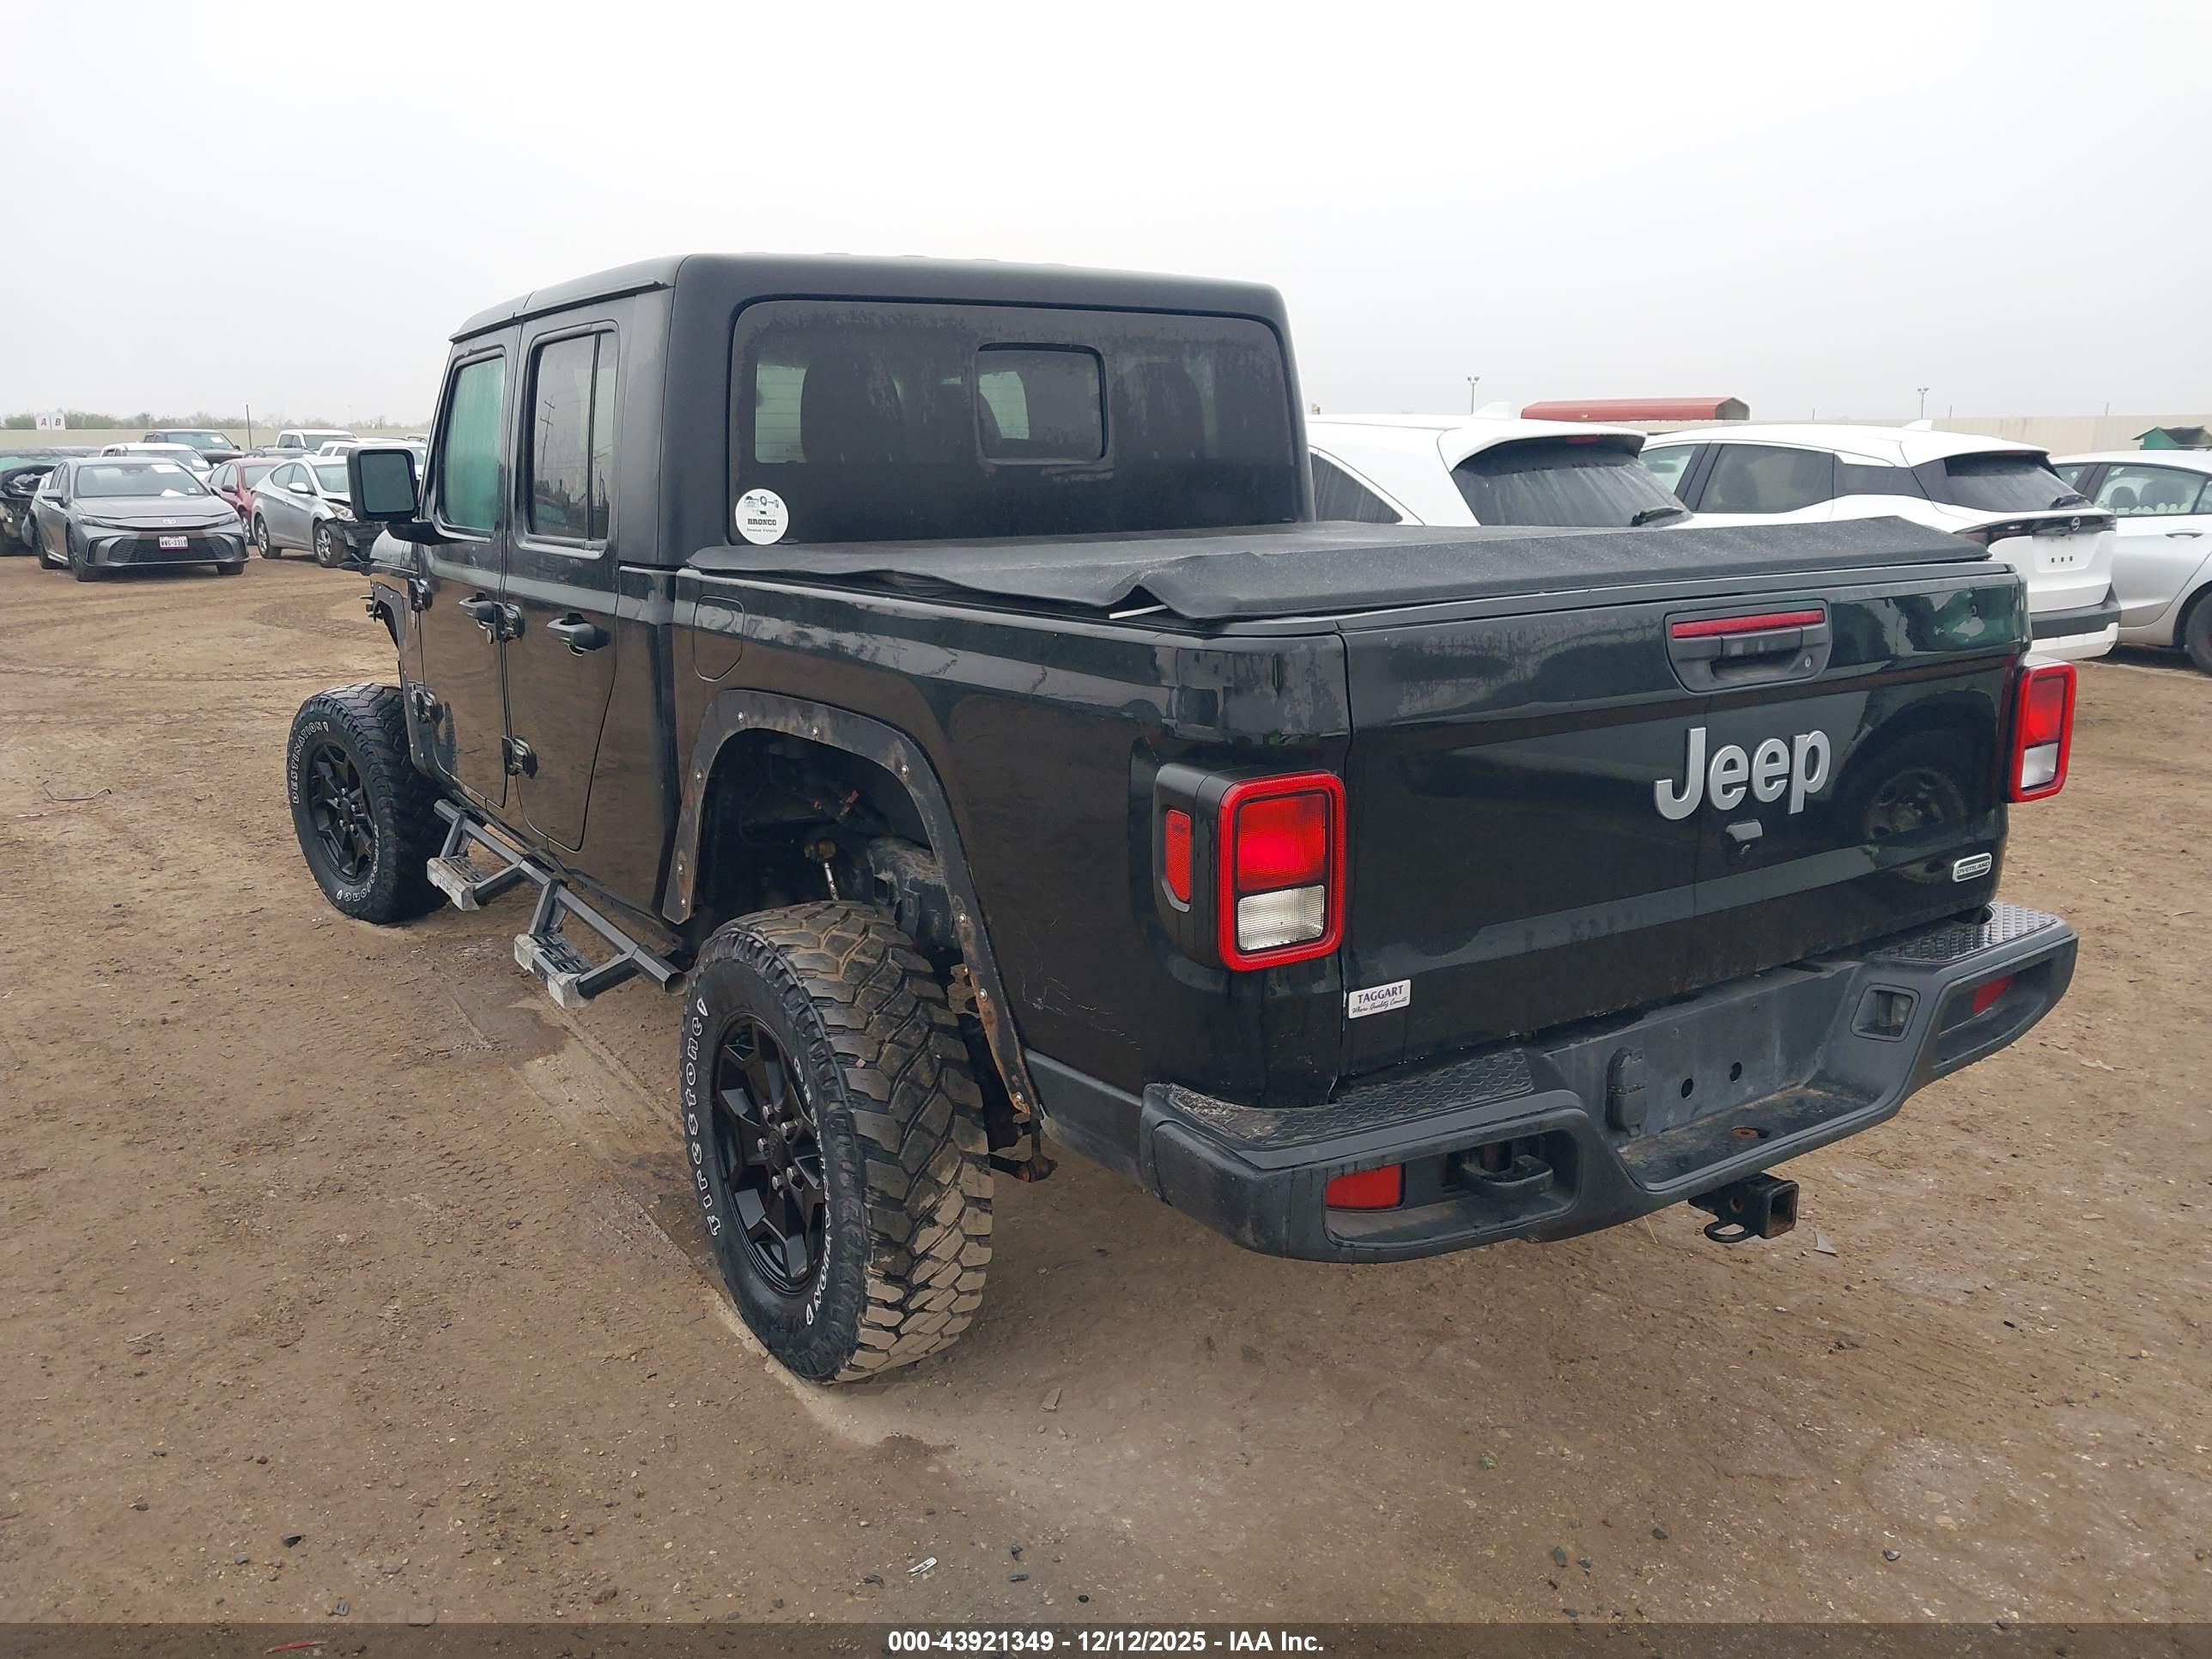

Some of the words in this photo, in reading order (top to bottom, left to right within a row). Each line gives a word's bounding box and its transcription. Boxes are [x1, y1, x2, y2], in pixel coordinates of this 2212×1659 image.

[40, 417, 47, 427] A
[55, 417, 62, 427] B
[1654, 726, 1831, 820] Jeep
[1358, 984, 1404, 1005] TAGGART
[1370, 1000, 1389, 1010] Quality
